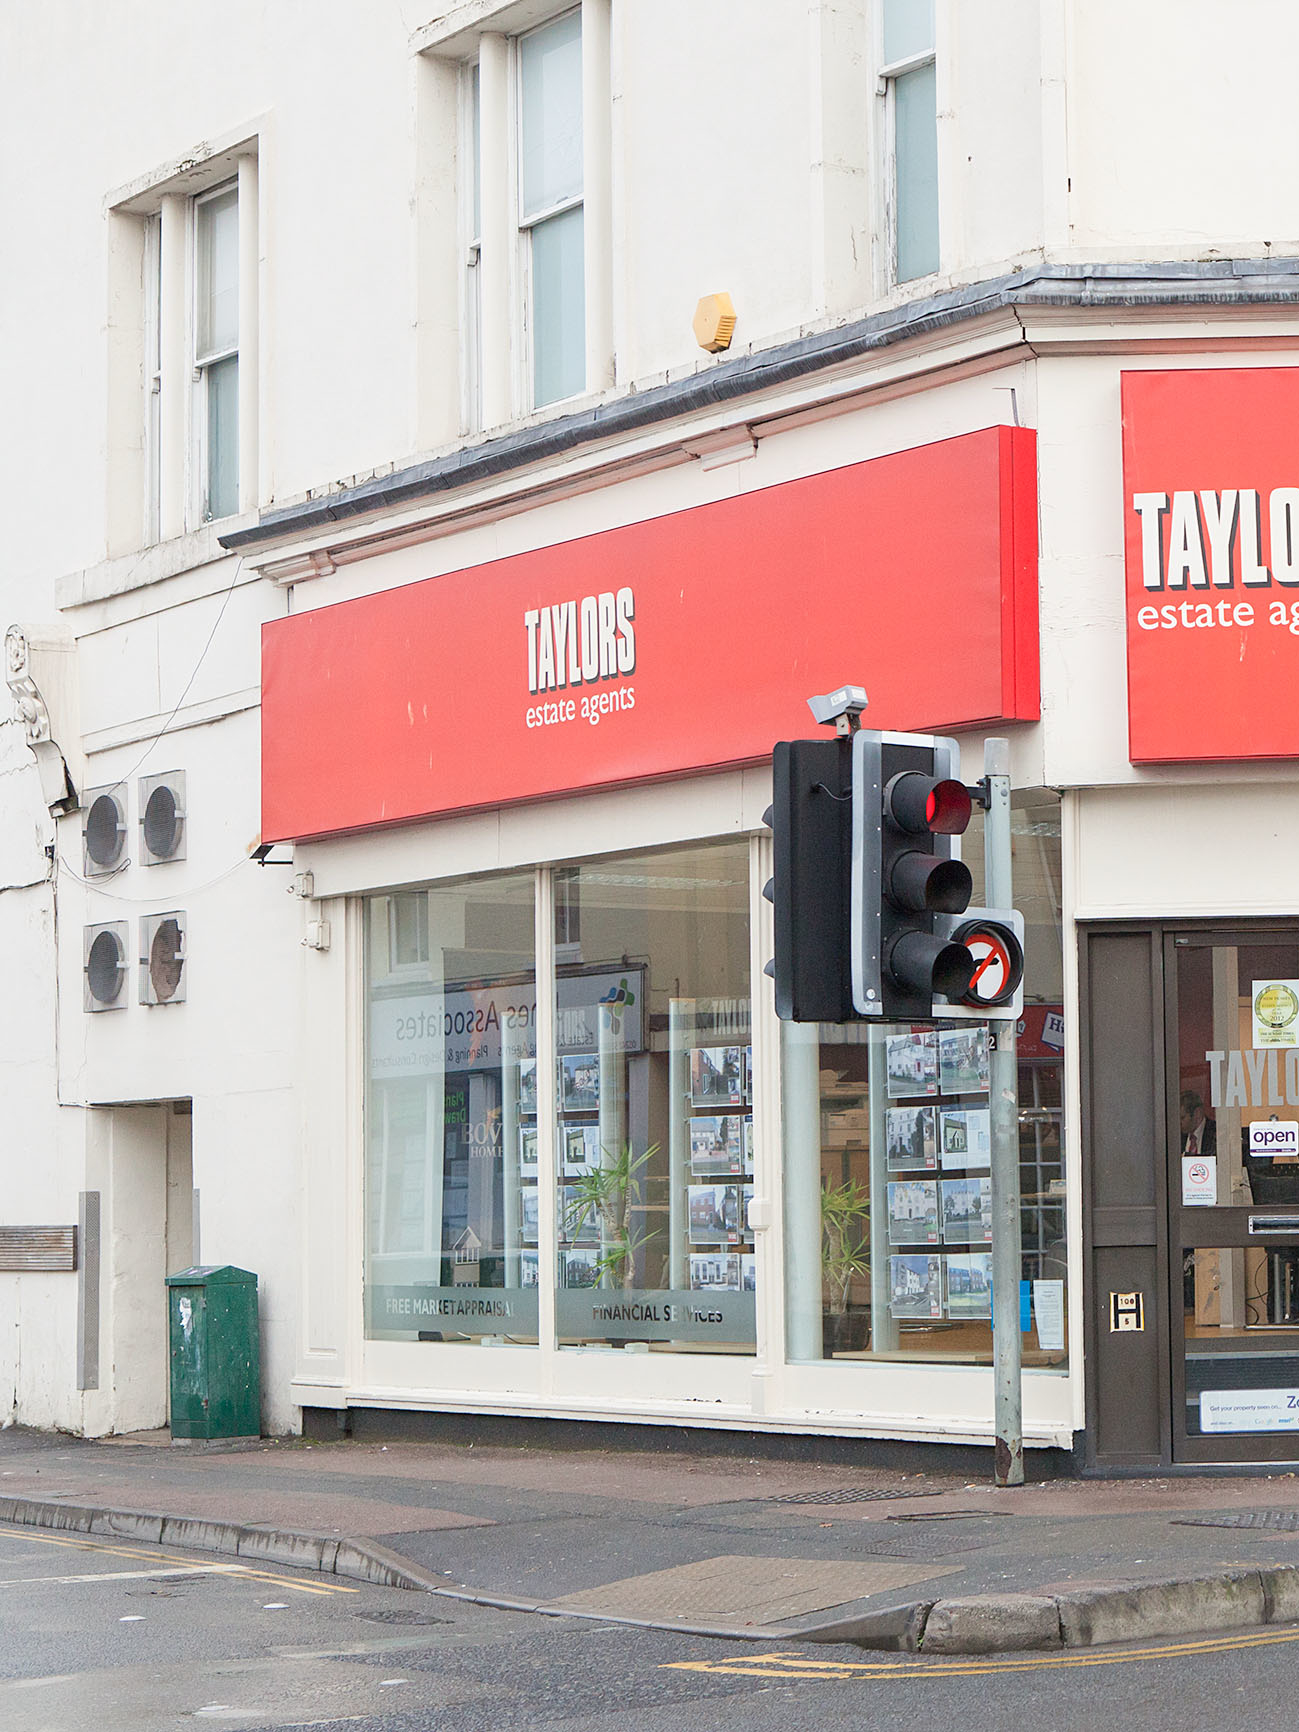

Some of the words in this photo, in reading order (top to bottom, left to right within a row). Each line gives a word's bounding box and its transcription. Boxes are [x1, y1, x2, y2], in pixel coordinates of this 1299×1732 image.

[1137, 600, 1255, 630] estate
[525, 587, 636, 696] TAYLORS
[526, 699, 576, 728] estate
[581, 686, 636, 725] agents
[988, 1035, 996, 1049] 2
[460, 1123, 503, 1144] BOV
[1253, 1131, 1295, 1146] open
[386, 1299, 411, 1314] FREE
[413, 1299, 455, 1315] MARKET
[592, 1304, 660, 1321] FINANCIAL
[1233, 1404, 1256, 1412] property
